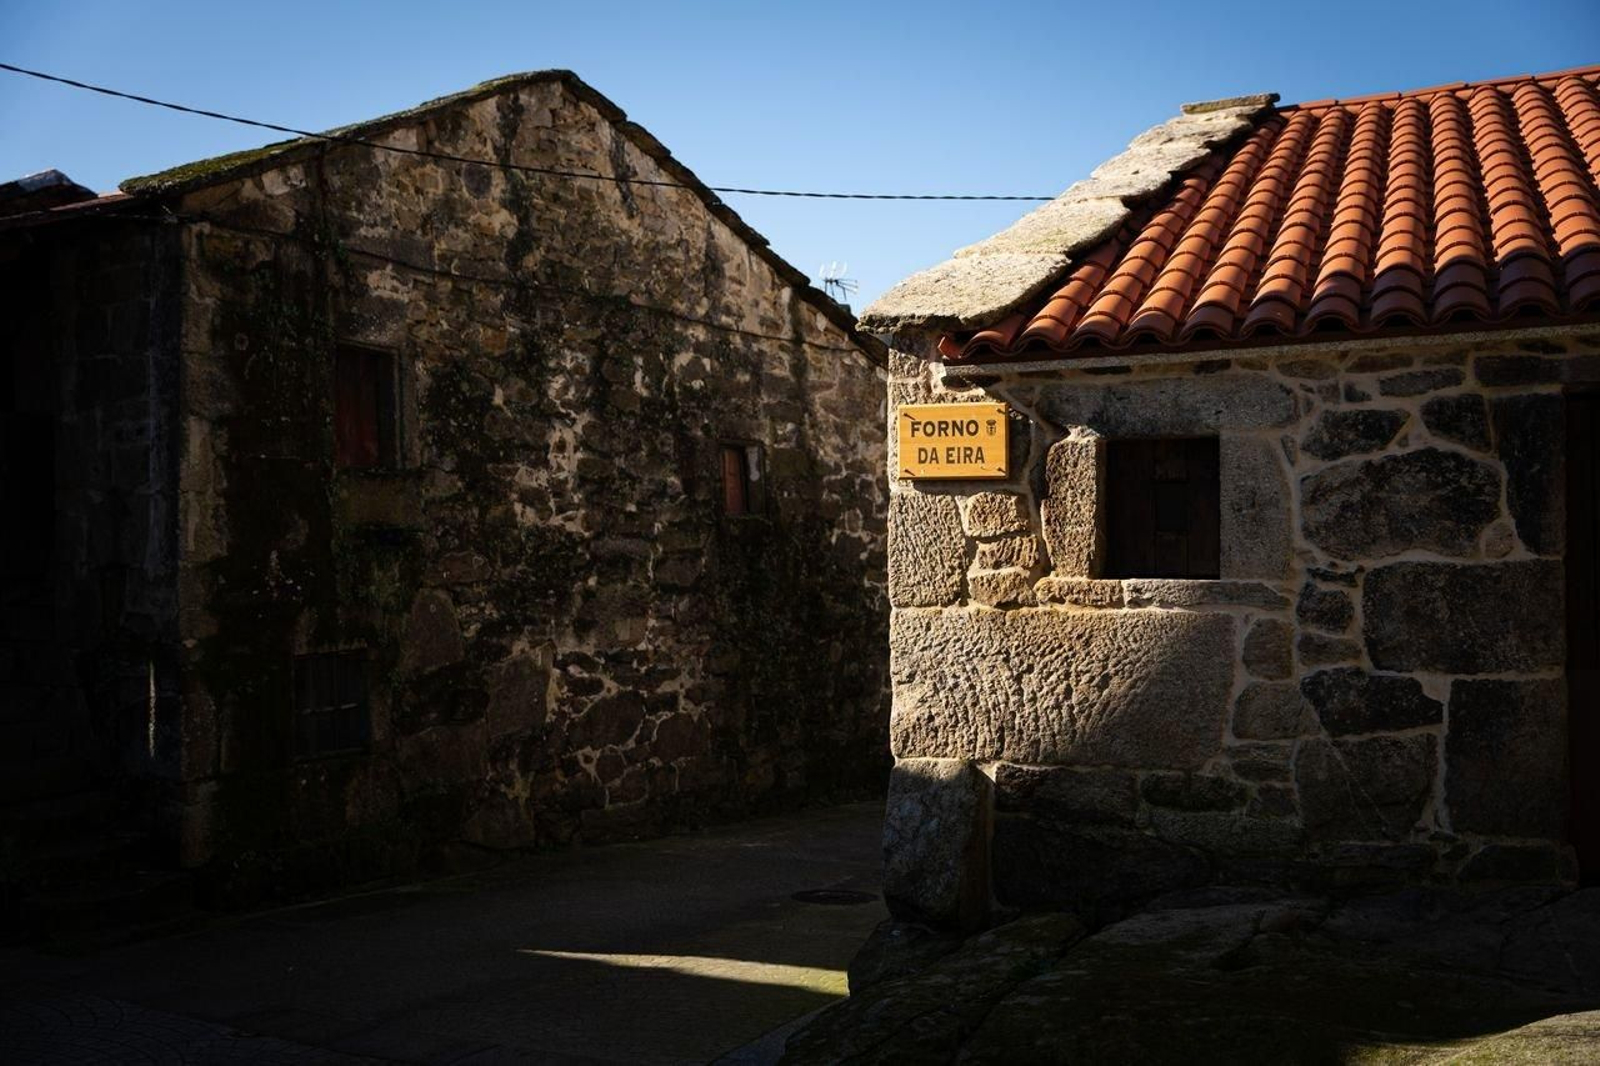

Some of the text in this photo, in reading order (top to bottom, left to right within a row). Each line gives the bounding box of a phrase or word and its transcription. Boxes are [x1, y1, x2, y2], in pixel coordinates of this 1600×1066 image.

[910, 419, 979, 438] FORNO
[918, 446, 985, 465] DA EIRA
